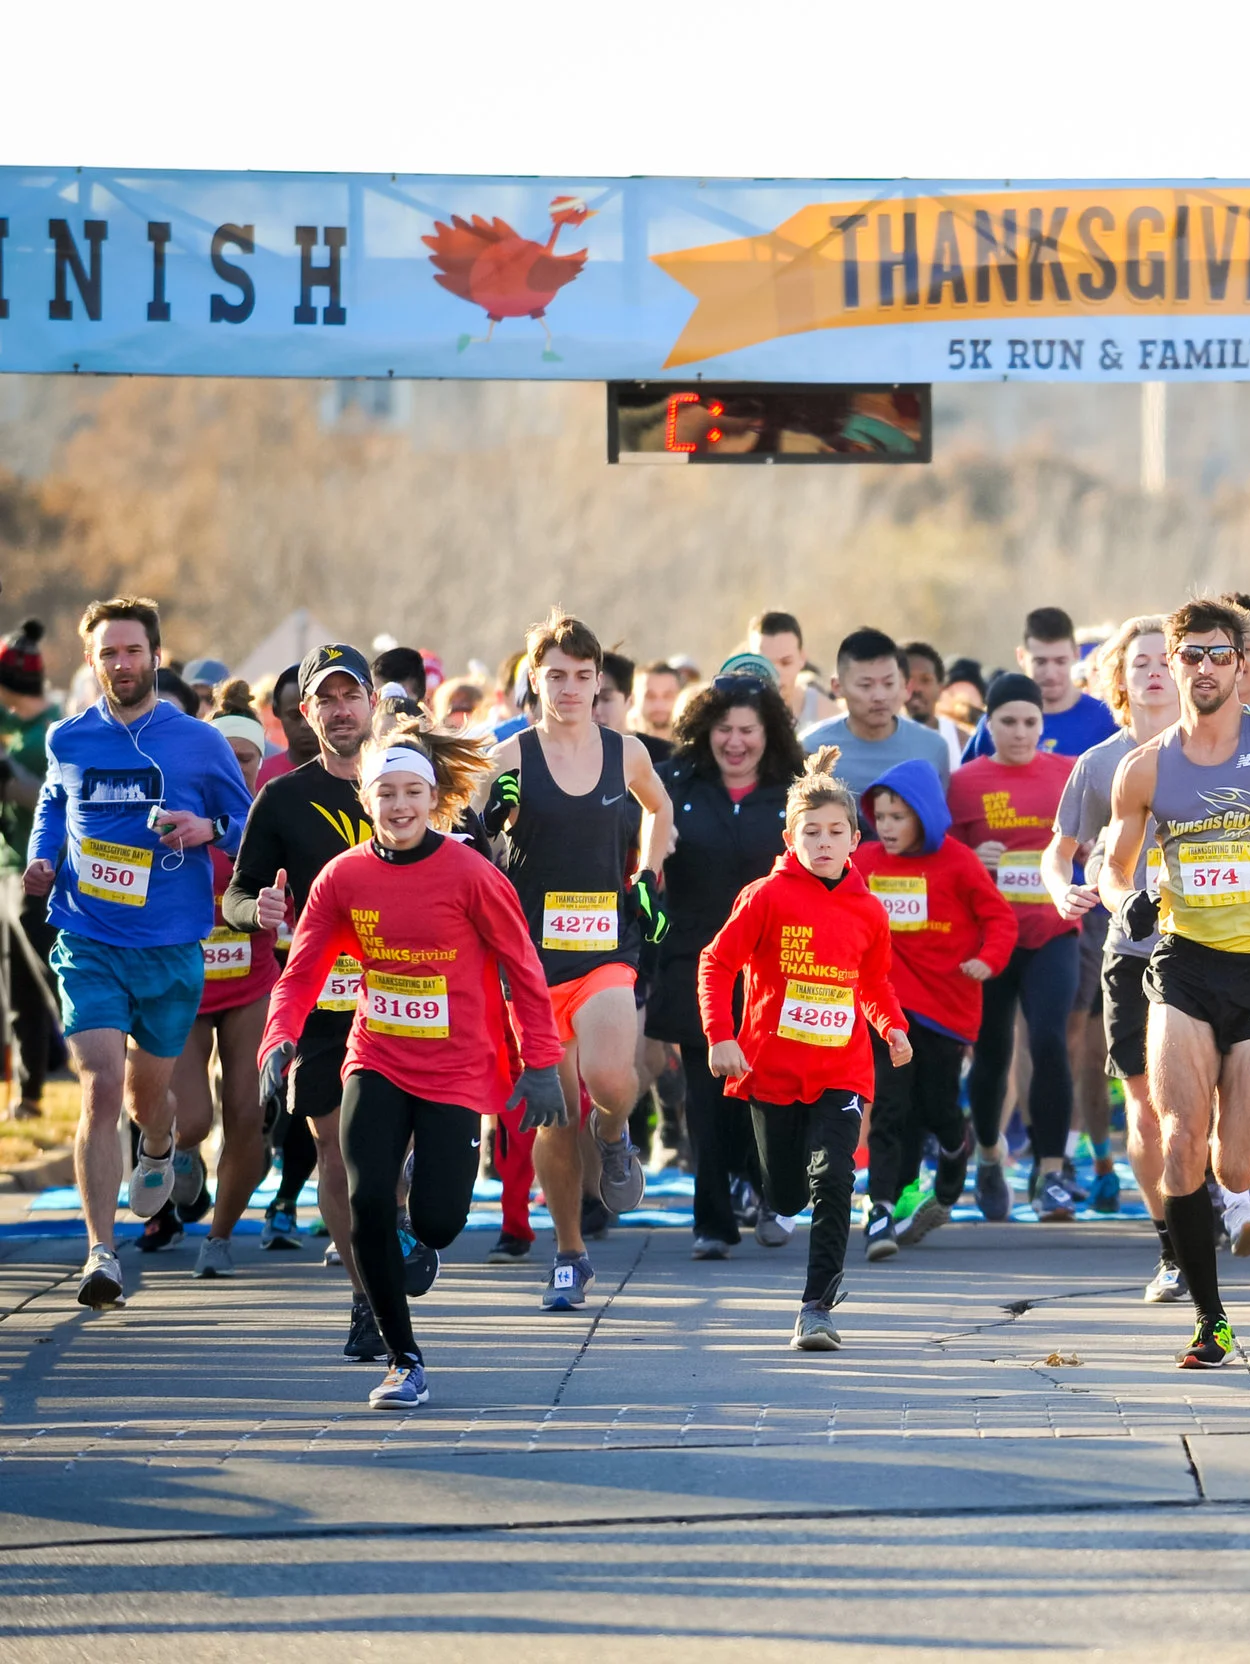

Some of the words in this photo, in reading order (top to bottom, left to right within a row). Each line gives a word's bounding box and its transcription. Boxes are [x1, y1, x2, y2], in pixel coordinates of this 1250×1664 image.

[947, 339, 992, 370] 5K
[1006, 339, 1085, 370] RUN
[1099, 339, 1123, 370] &
[982, 792, 1011, 802] RUN
[984, 800, 1008, 811] EAT
[985, 808, 1016, 821] GIVE
[1188, 844, 1229, 856] THANKSGIVING
[1231, 844, 1243, 854] DAY
[91, 863, 135, 887] 950
[1193, 868, 1239, 887] 574
[350, 908, 380, 923] RUN
[550, 915, 611, 933] 4276
[781, 925, 813, 938] RUN
[780, 938, 809, 951] EAT
[780, 950, 815, 963] GIVE
[374, 975, 421, 989] THANKSGIVING
[423, 979, 436, 989] DAY
[795, 984, 837, 998] THANKSGIVING
[373, 995, 440, 1020] 3169
[787, 1006, 848, 1028] 4269
